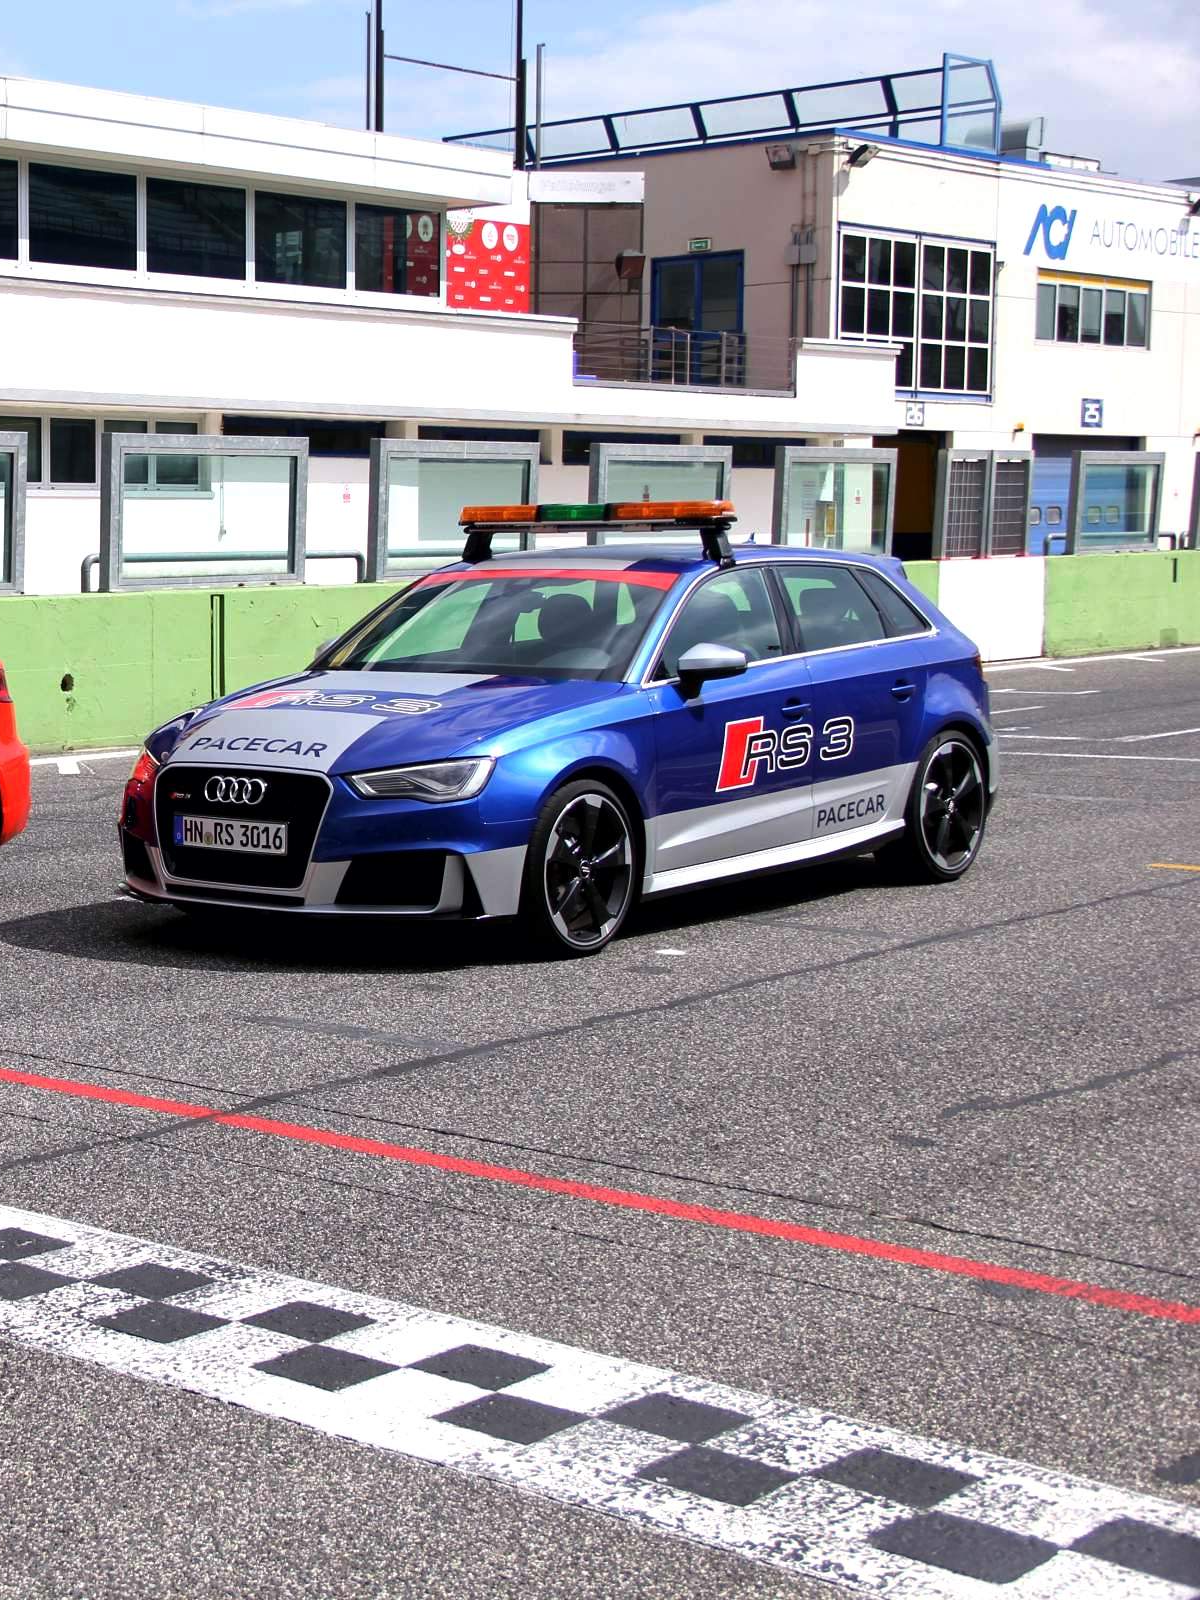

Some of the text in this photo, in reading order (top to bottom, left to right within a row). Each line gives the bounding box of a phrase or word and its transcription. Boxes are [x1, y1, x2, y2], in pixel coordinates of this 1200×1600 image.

[188, 737, 328, 758] PACECAR
[819, 716, 854, 762] 3
[816, 794, 885, 827] PACECAR
[184, 819, 283, 850] HN RS 3016
